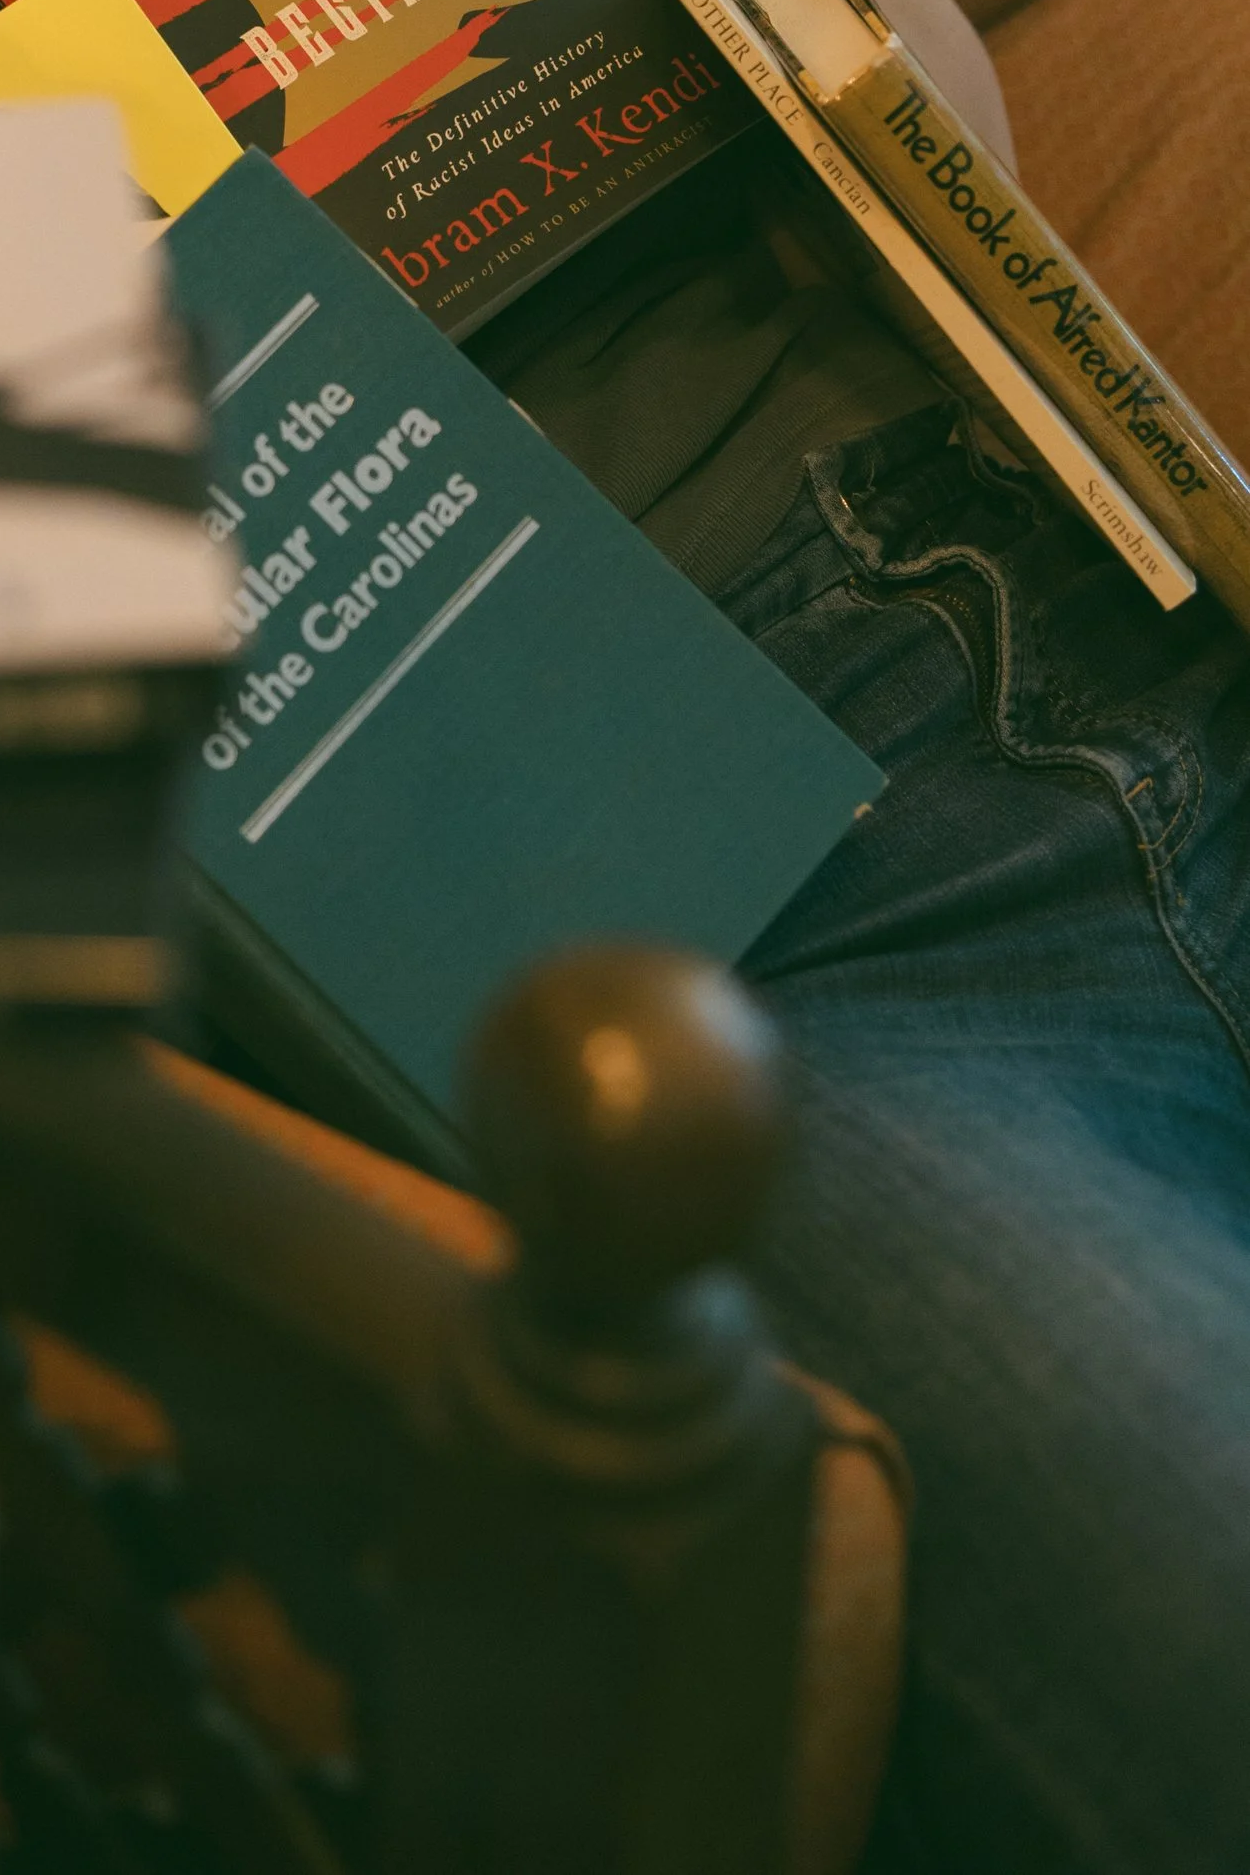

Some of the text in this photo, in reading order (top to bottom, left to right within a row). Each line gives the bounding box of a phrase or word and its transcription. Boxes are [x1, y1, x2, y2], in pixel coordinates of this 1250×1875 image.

[381, 31, 606, 181] The Definitive History
[381, 52, 722, 288] bram X. Kendi
[386, 44, 644, 220] of Racist Ideas in America
[436, 116, 713, 309] author of HOW TO BE AN ANTIRACIST
[748, 61, 804, 126] PLACE
[813, 142, 871, 215] Cancian
[1080, 478, 1163, 579] Scrimshaw
[884, 80, 1209, 498] The Book of Alfred Kantor
[220, 406, 442, 637] ular Flora
[241, 432, 290, 497] of
[280, 382, 355, 452] the
[201, 472, 478, 771] of the Carolinas
